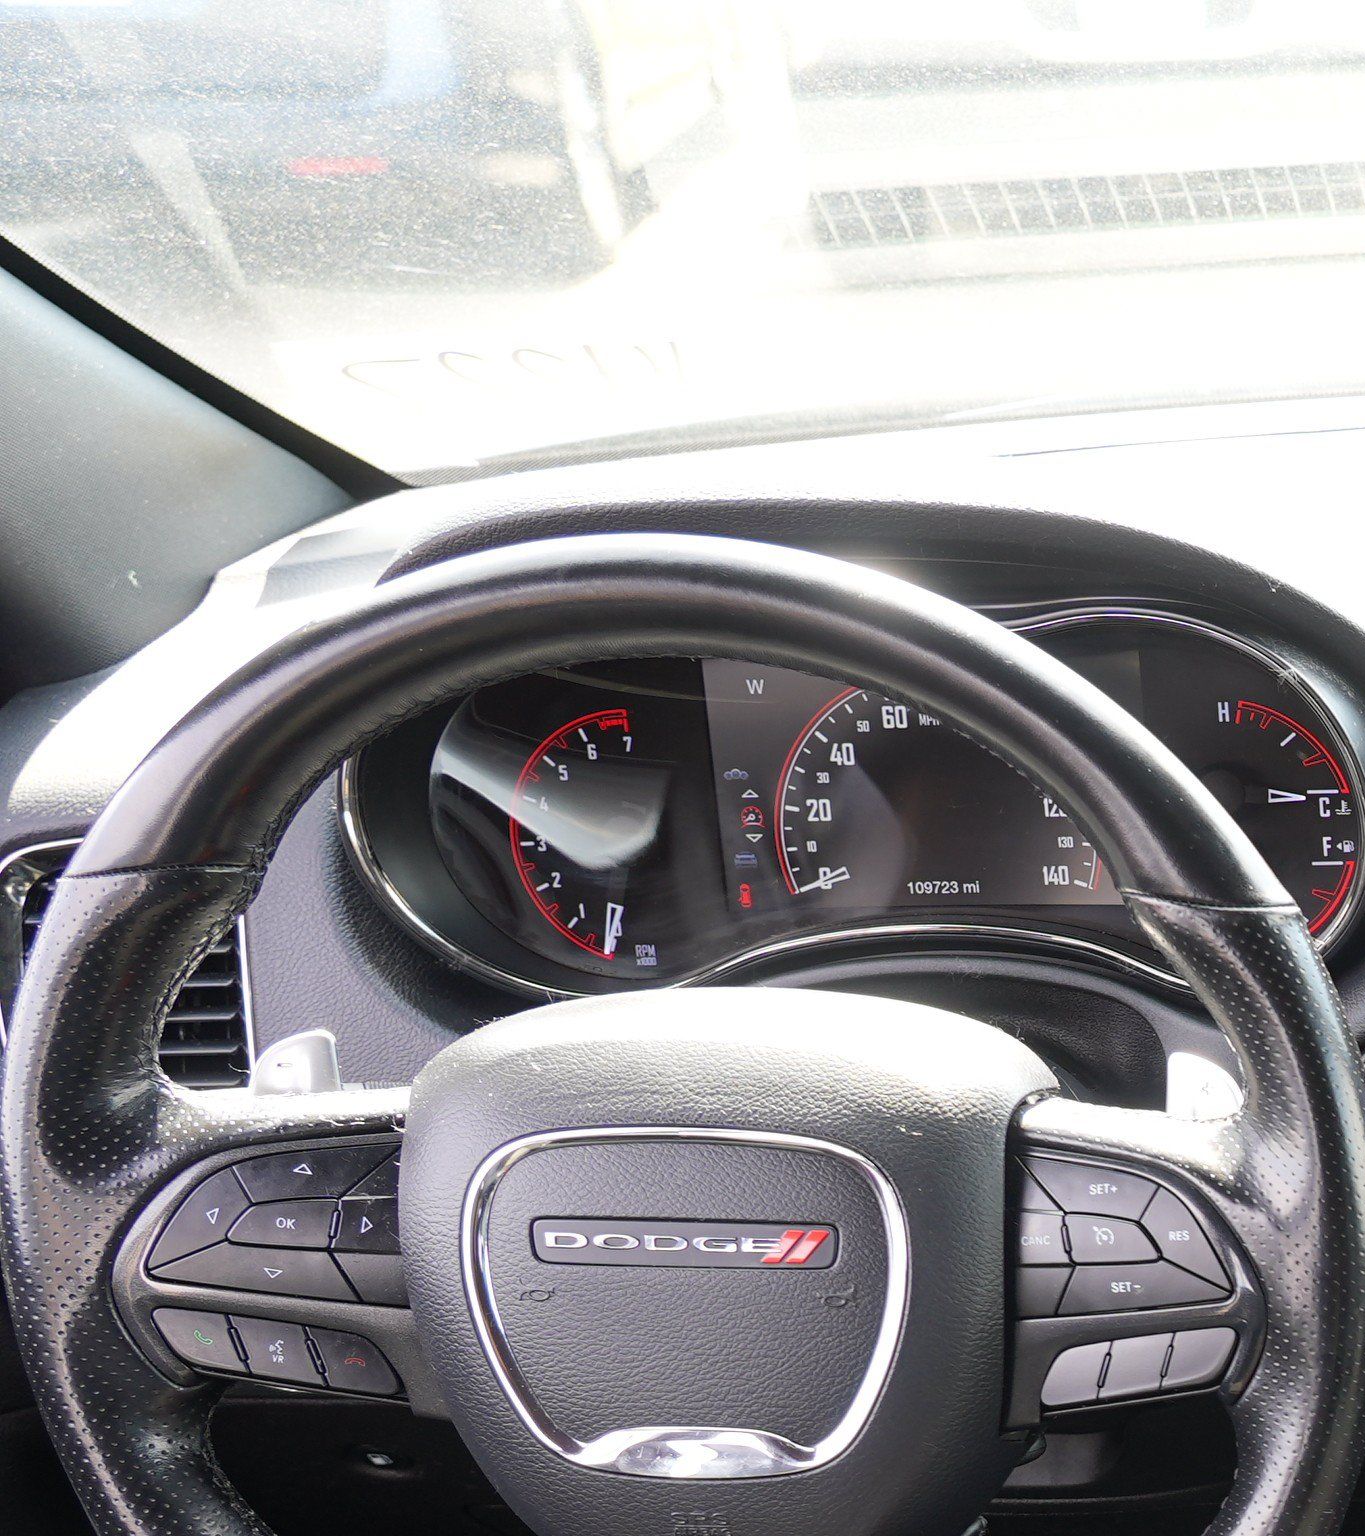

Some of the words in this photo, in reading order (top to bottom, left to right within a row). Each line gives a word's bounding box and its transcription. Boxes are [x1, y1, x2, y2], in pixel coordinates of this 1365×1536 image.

[746, 679, 764, 695] W
[881, 705, 908, 729] 60
[1218, 702, 1230, 722] H
[856, 720, 870, 732] 50
[587, 743, 597, 760] 6
[623, 736, 632, 752] 7
[830, 743, 855, 766] 40
[559, 765, 568, 781] 5
[817, 772, 830, 784] 30
[539, 797, 549, 812] 4
[806, 798, 832, 821] 20
[1043, 797, 1068, 818] 12
[1319, 797, 1331, 817] C
[536, 836, 547, 852] 3
[806, 840, 817, 852] 10
[1057, 836, 1074, 848] 130
[1323, 836, 1332, 857] F
[551, 872, 562, 888] 2
[1043, 865, 1069, 885] 140
[907, 881, 959, 895] 109723
[963, 881, 980, 894] mi
[579, 903, 586, 919] 1
[635, 944, 656, 957] RPM
[276, 1217, 296, 1230] OK
[544, 1231, 782, 1254] DODGE
[1021, 1235, 1050, 1246] CANC
[1169, 1230, 1190, 1241] RES
[272, 1354, 285, 1364] VR
